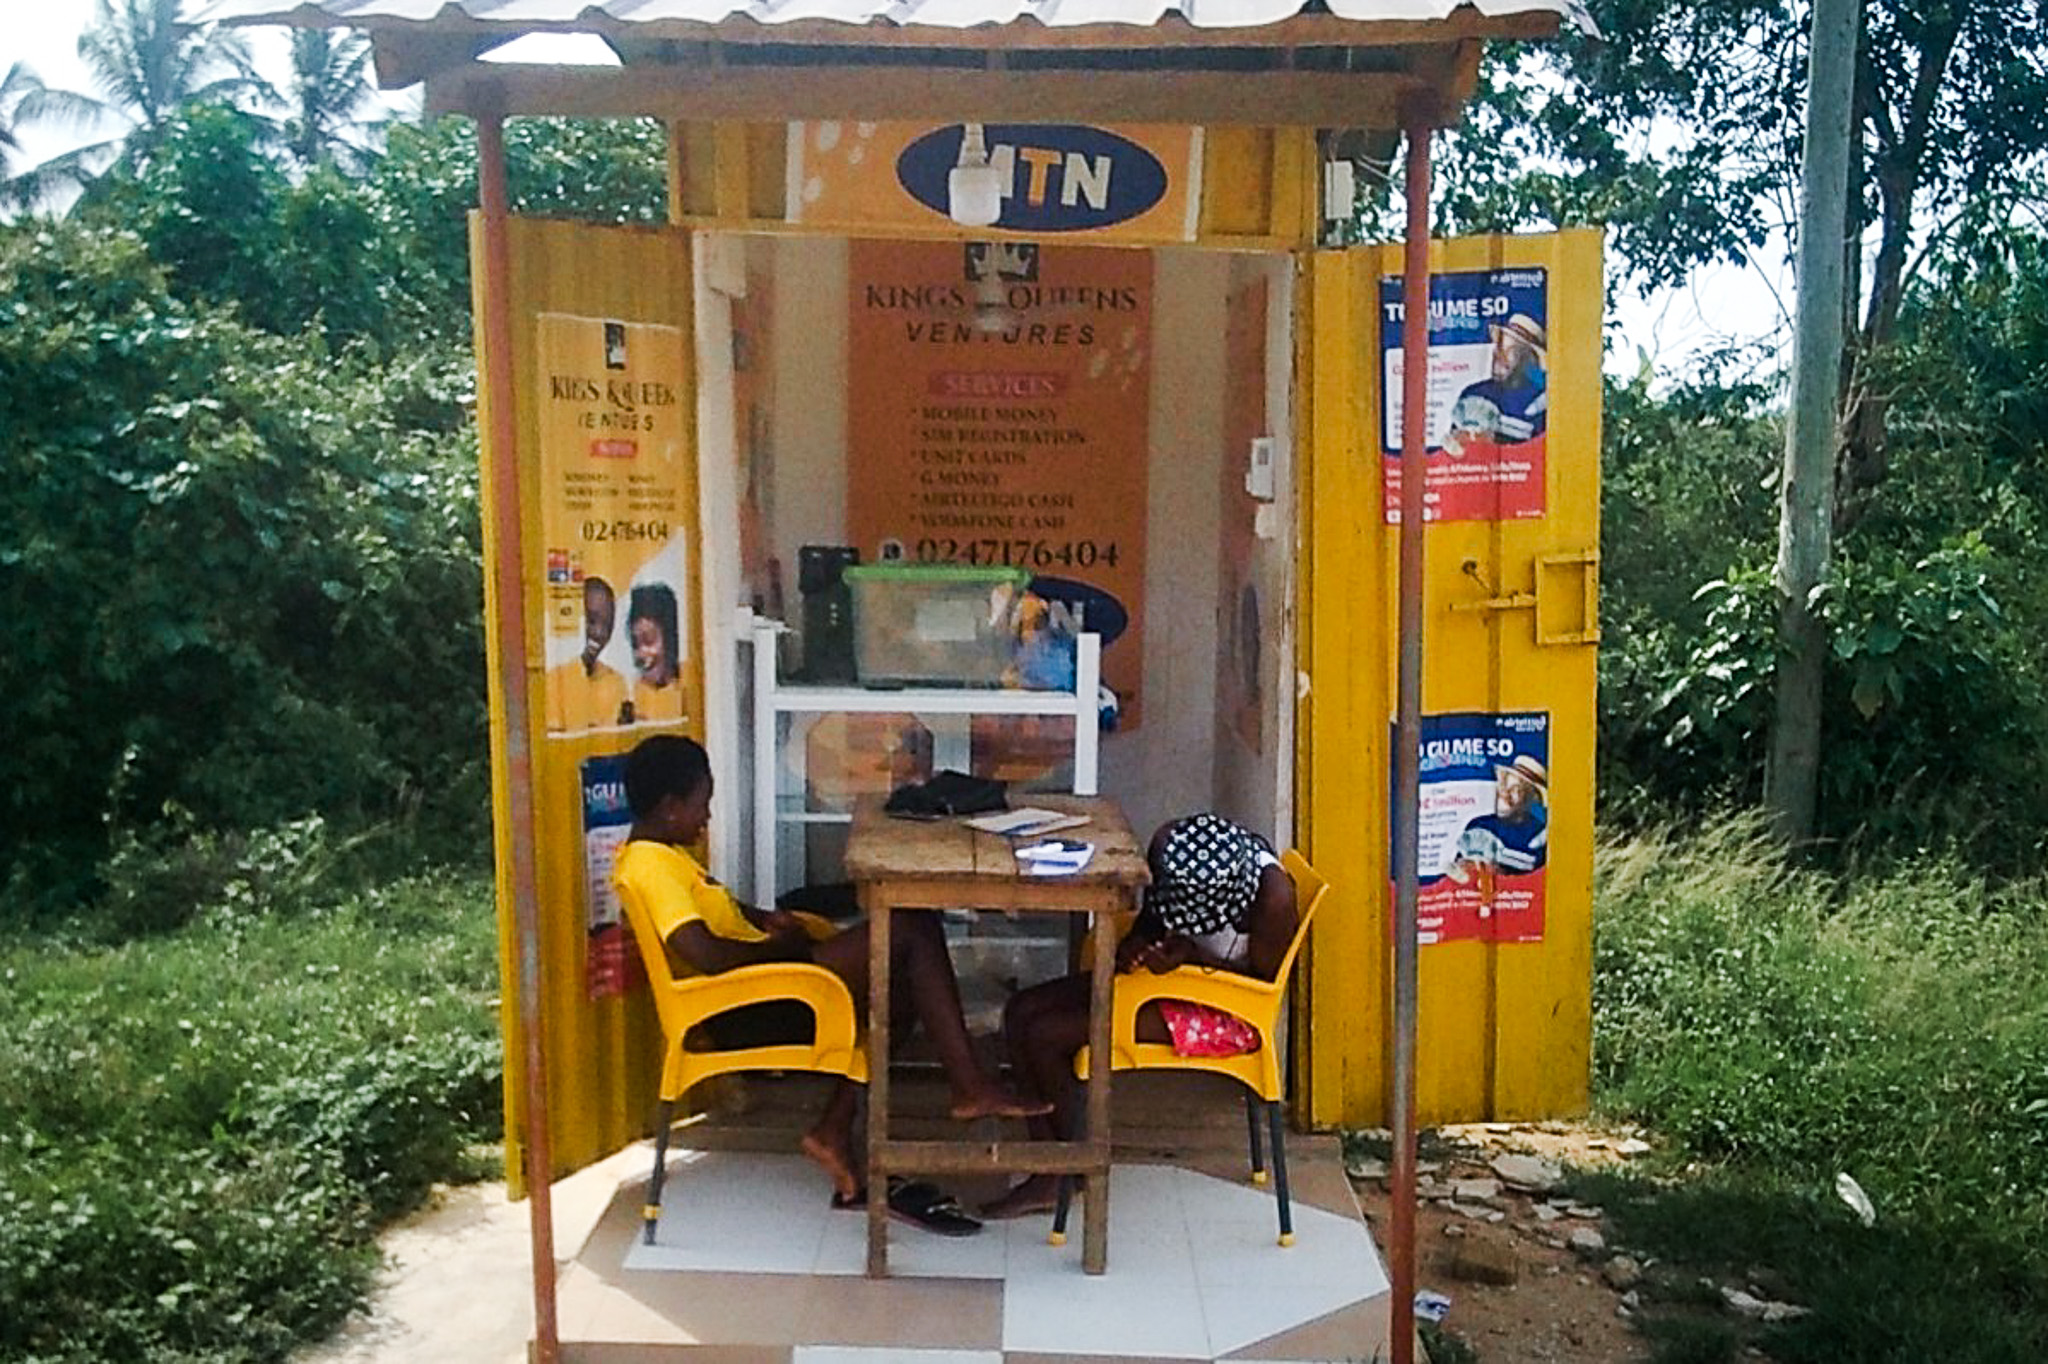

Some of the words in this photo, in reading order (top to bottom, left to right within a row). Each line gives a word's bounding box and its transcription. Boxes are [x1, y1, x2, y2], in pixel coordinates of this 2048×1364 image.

[866, 284, 966, 309] KINGS
[1446, 299, 1478, 318] ME
[1481, 296, 1509, 316] SO
[916, 538, 1120, 568] 0247176404
[1452, 738, 1485, 756] ME
[1487, 738, 1514, 757] SO
